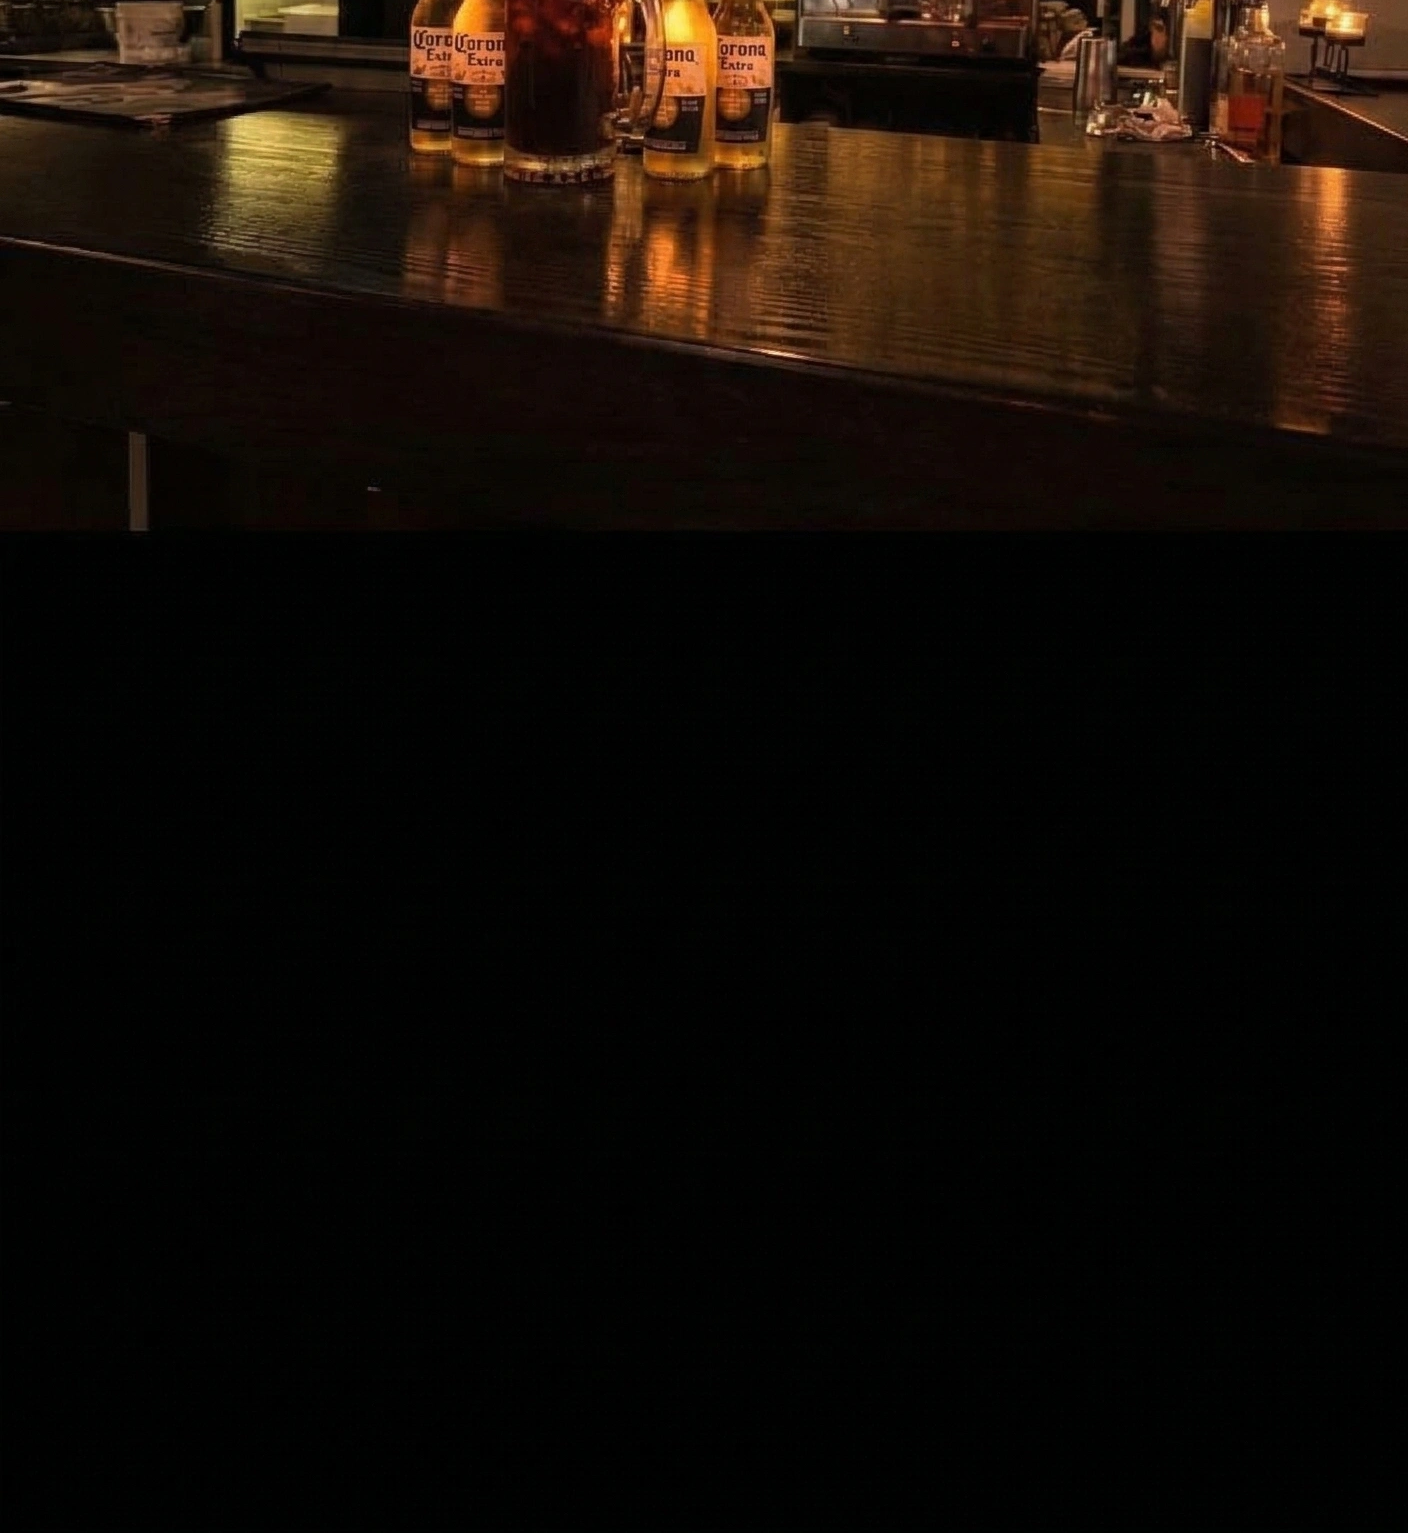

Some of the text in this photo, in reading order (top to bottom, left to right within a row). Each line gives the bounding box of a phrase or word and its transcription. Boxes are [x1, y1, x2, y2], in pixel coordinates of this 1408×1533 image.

[414, 30, 453, 50] Coro
[455, 33, 505, 54] Coron
[718, 38, 766, 57] orona
